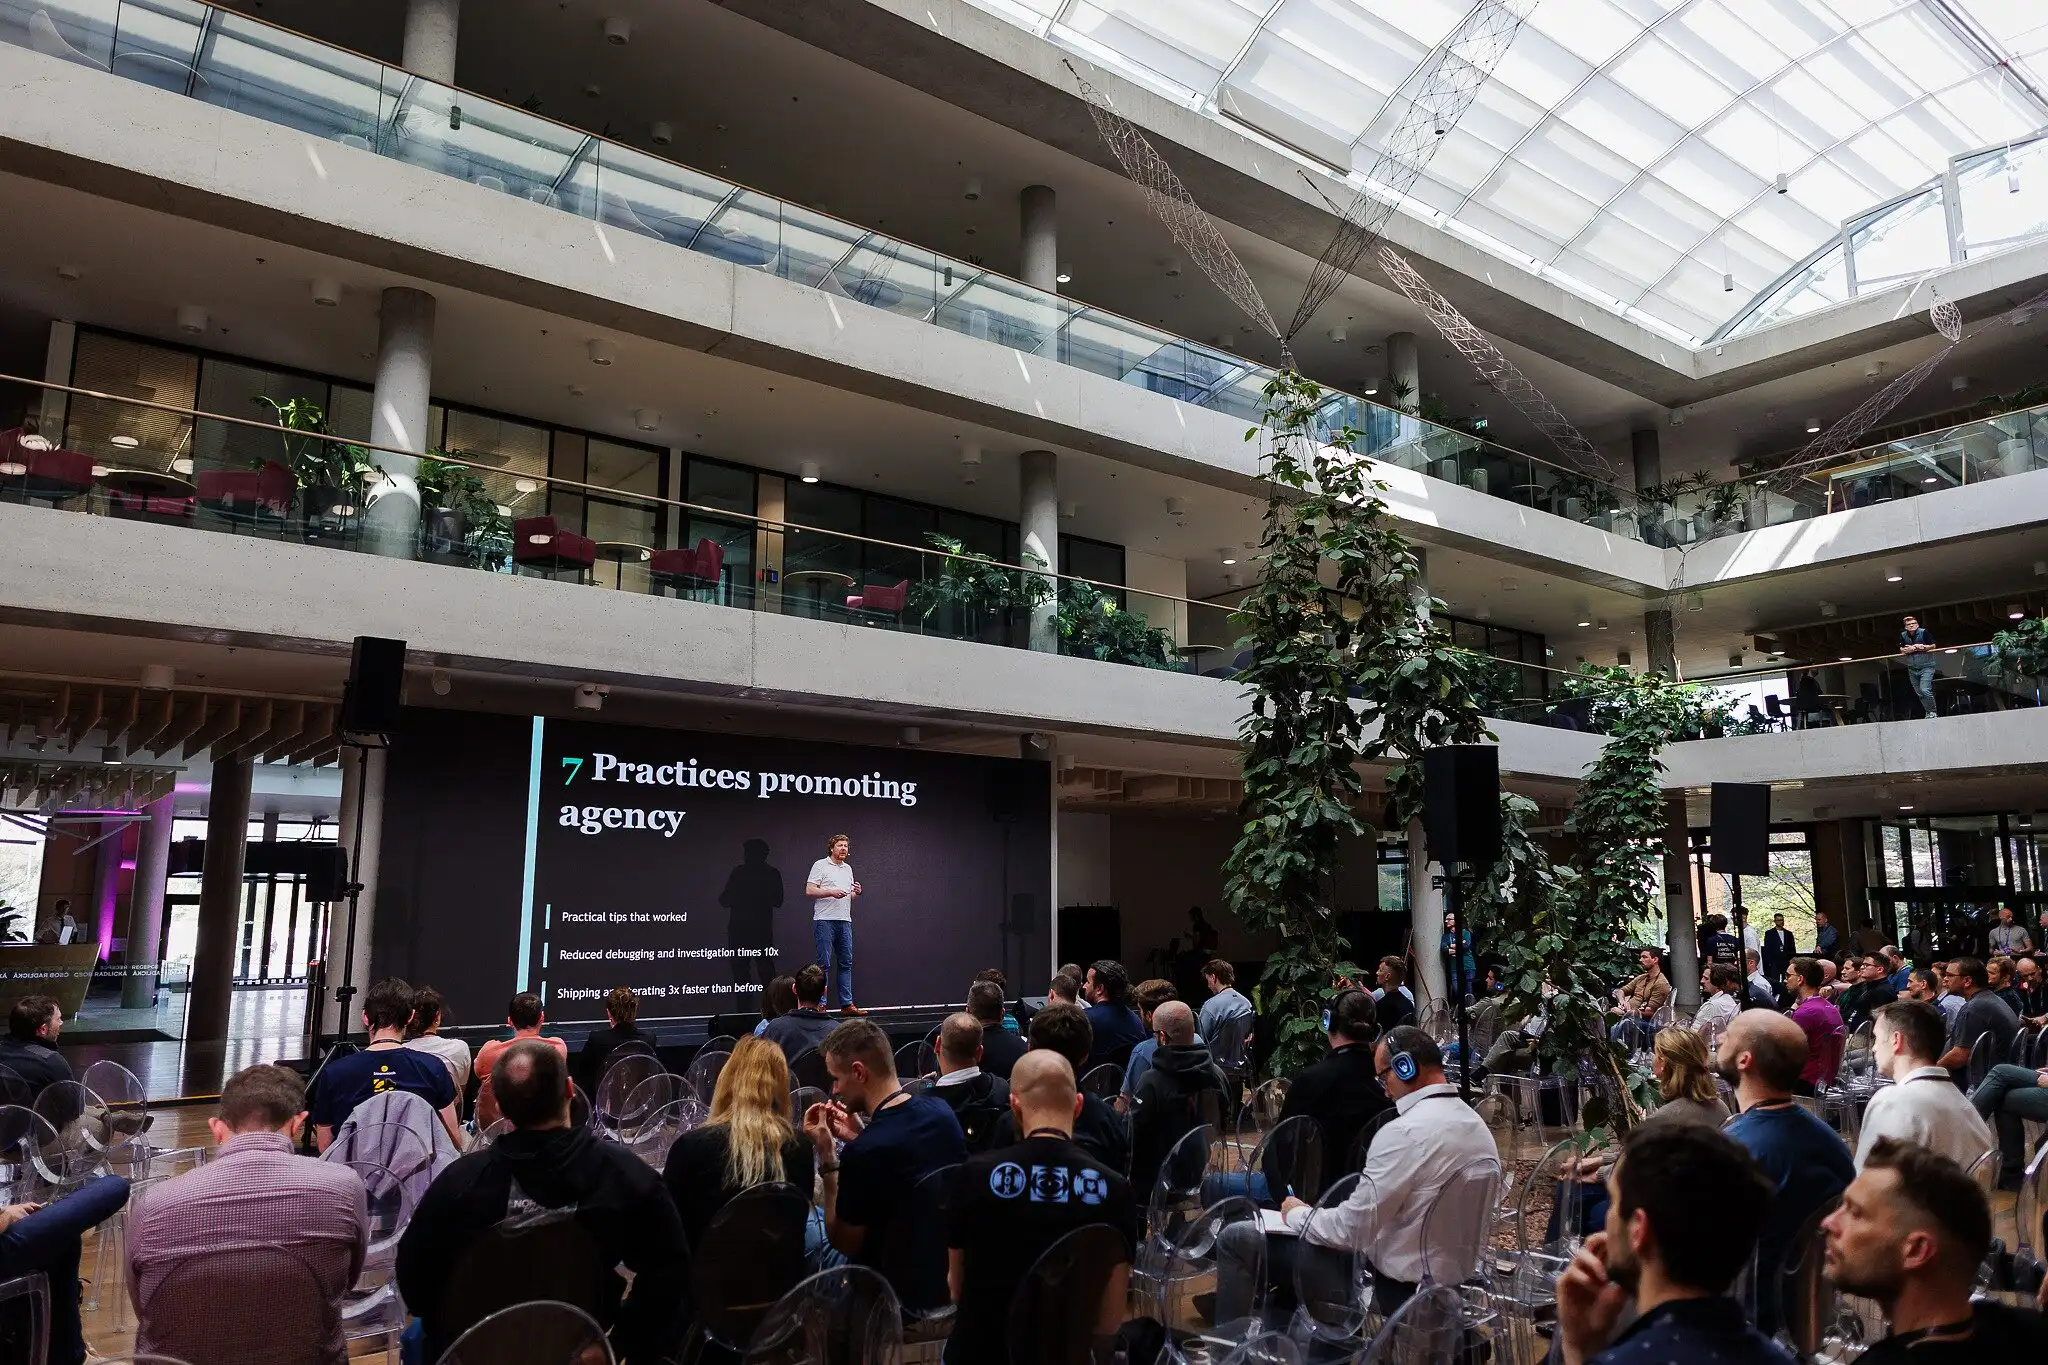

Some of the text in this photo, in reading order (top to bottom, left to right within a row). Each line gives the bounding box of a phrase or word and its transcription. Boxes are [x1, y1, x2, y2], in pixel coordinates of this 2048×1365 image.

[562, 753, 918, 807] 7 Practices promoting
[558, 806, 687, 838] agency
[561, 911, 688, 924] Practical tips that worked
[559, 946, 779, 962] Reduced debugging and investigation times 10x
[557, 987, 601, 1001] Shipping
[667, 984, 680, 996] 3x
[681, 983, 710, 996] faster
[711, 982, 732, 995] than
[734, 982, 764, 994] before
